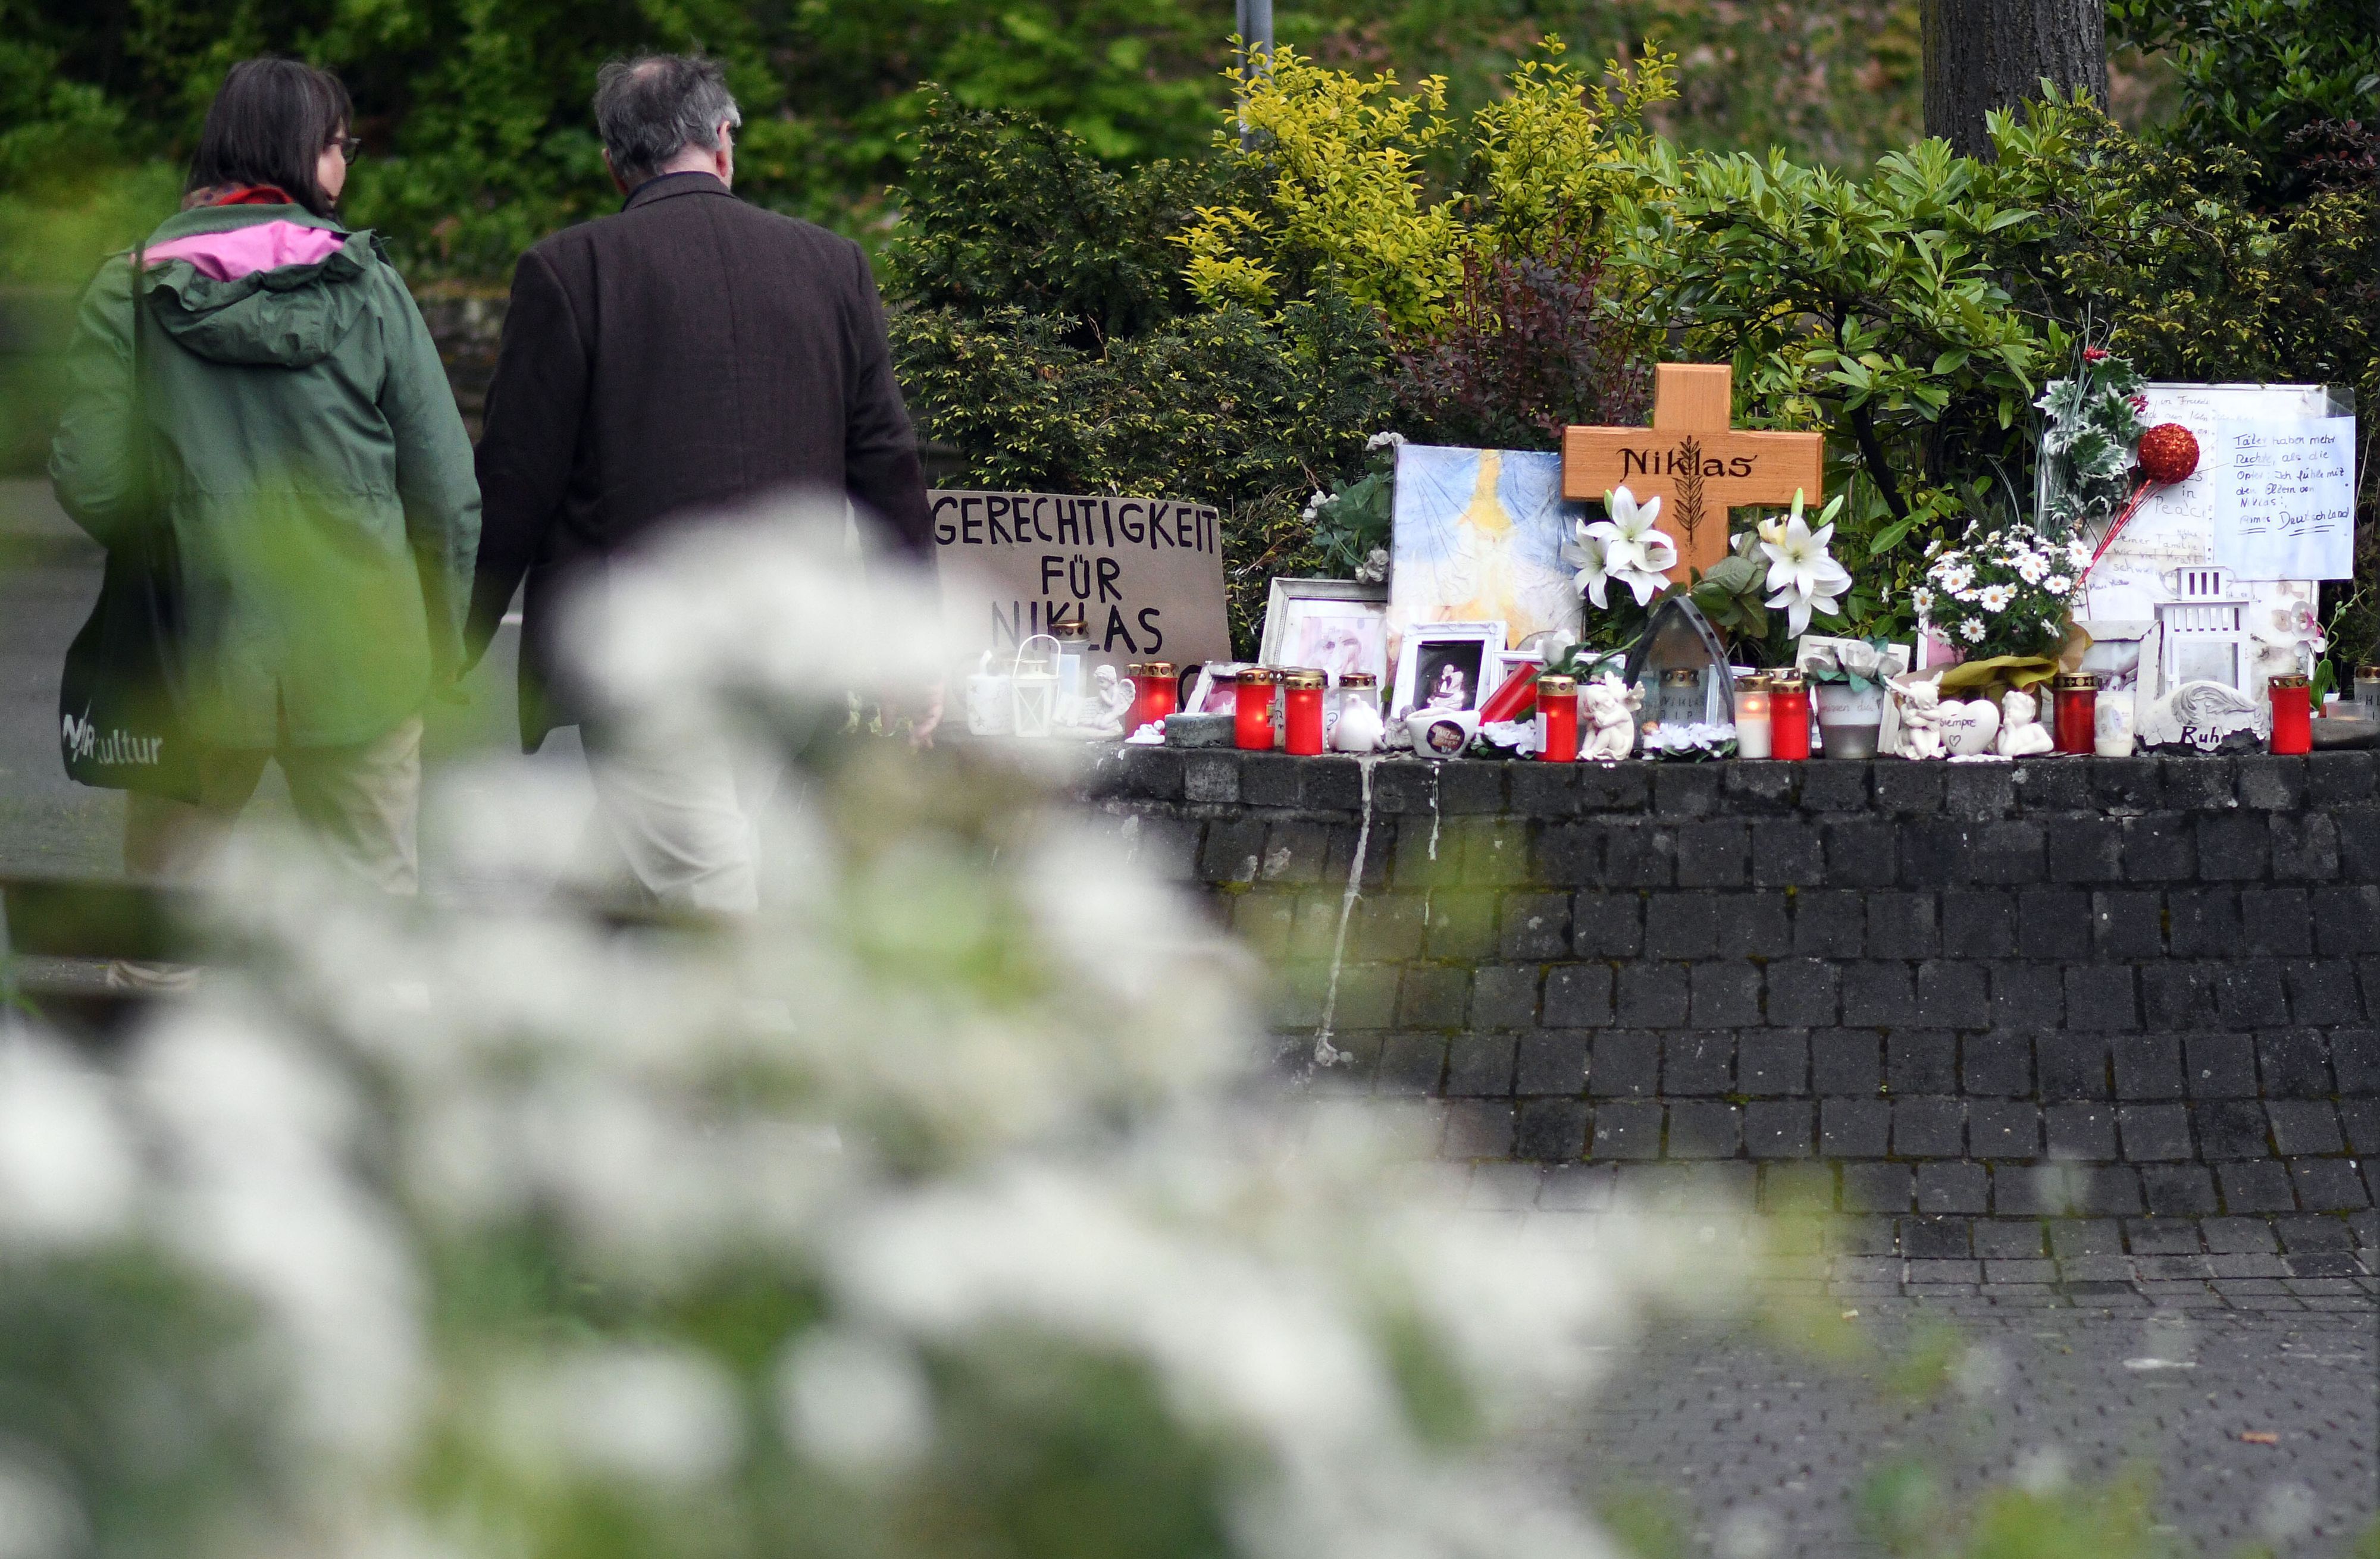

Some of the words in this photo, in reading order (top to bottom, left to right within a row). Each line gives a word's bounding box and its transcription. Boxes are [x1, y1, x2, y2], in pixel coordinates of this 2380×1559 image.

[2232, 432, 2267, 446] Täter
[2272, 435, 2304, 446] haben
[2310, 432, 2336, 445] mehr
[2281, 452, 2301, 462] als
[2309, 450, 2329, 460] die
[1615, 447, 1758, 483] Niklas
[2275, 470, 2292, 481] Ich
[2296, 467, 2324, 482] fühle
[2326, 467, 2345, 478] mit
[2181, 485, 2197, 499] in
[2235, 486, 2257, 496] den
[932, 495, 1217, 554] GERECHTIGKEIT
[2276, 506, 2350, 531] Deutschland
[1041, 554, 1123, 603] FÜR
